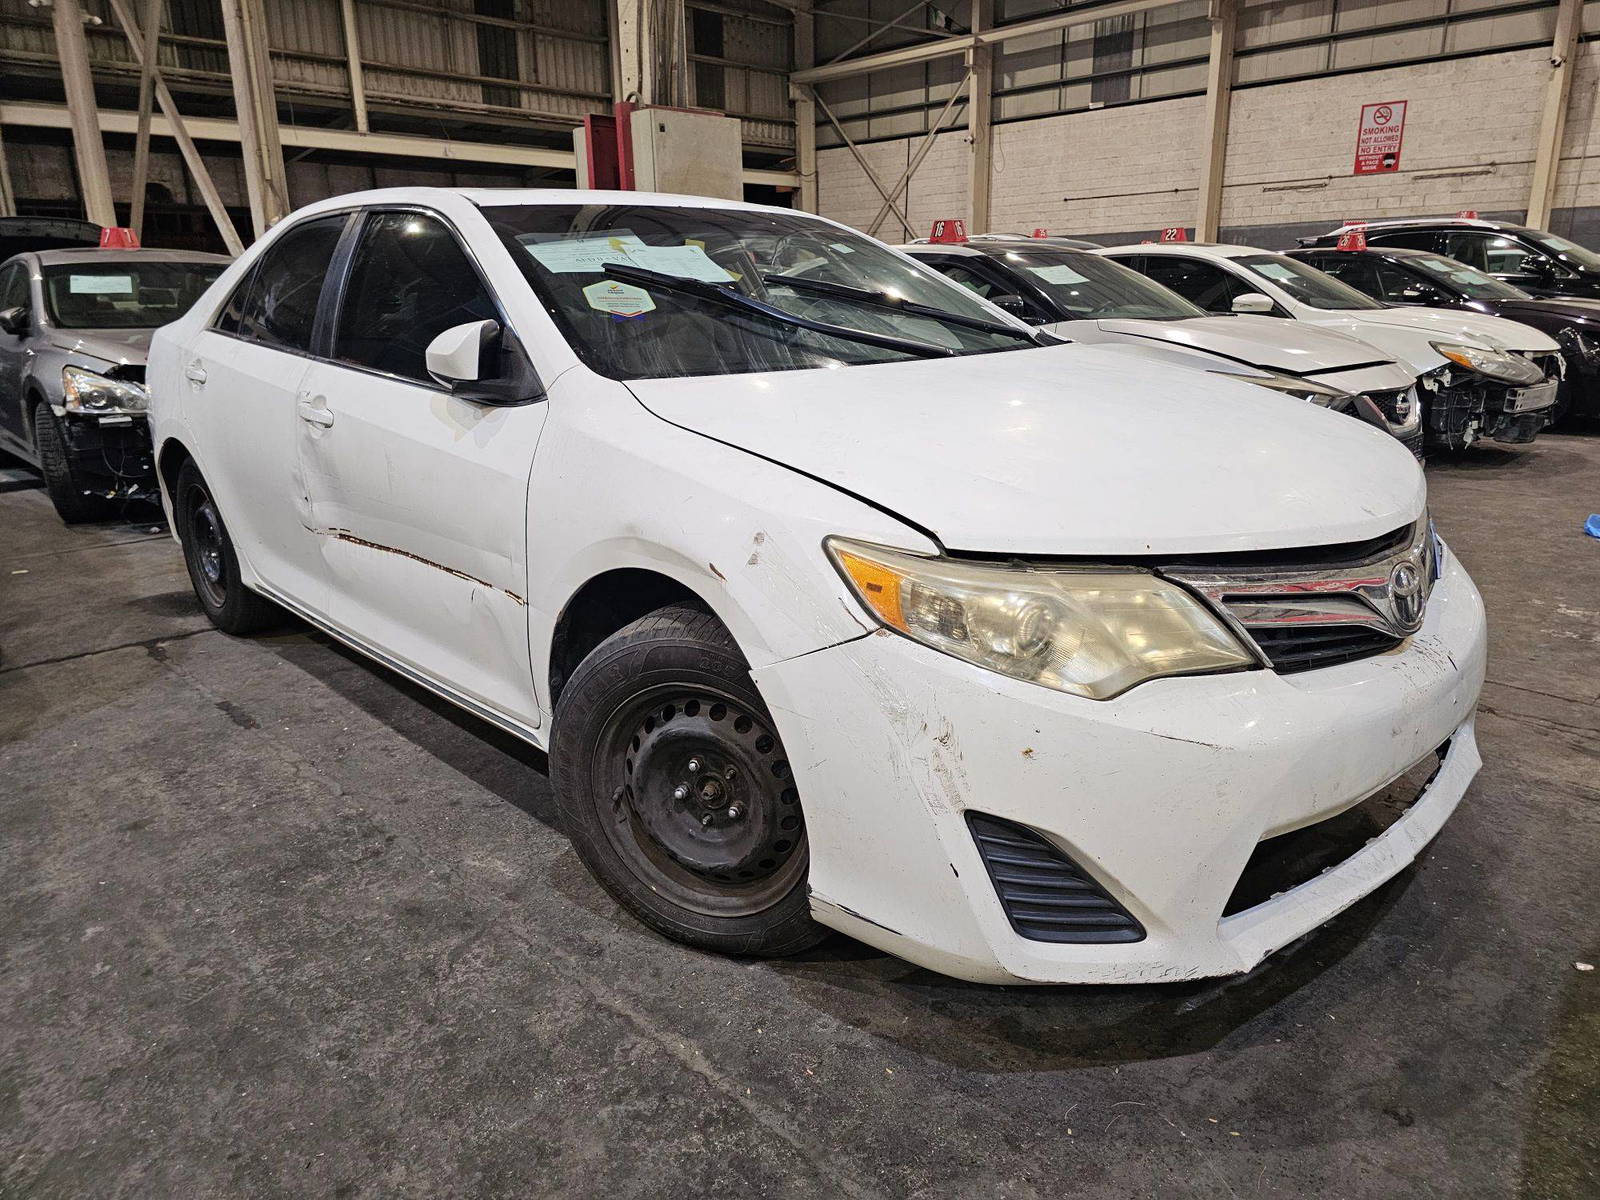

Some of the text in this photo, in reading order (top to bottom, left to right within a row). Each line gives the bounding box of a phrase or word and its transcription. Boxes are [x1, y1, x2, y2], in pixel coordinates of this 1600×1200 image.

[1362, 125, 1400, 136] SMOKING
[1361, 135, 1399, 144] NOT ALLOWED
[1373, 145, 1397, 153] ENTRY
[935, 221, 945, 237] 16
[1165, 228, 1178, 240] 22
